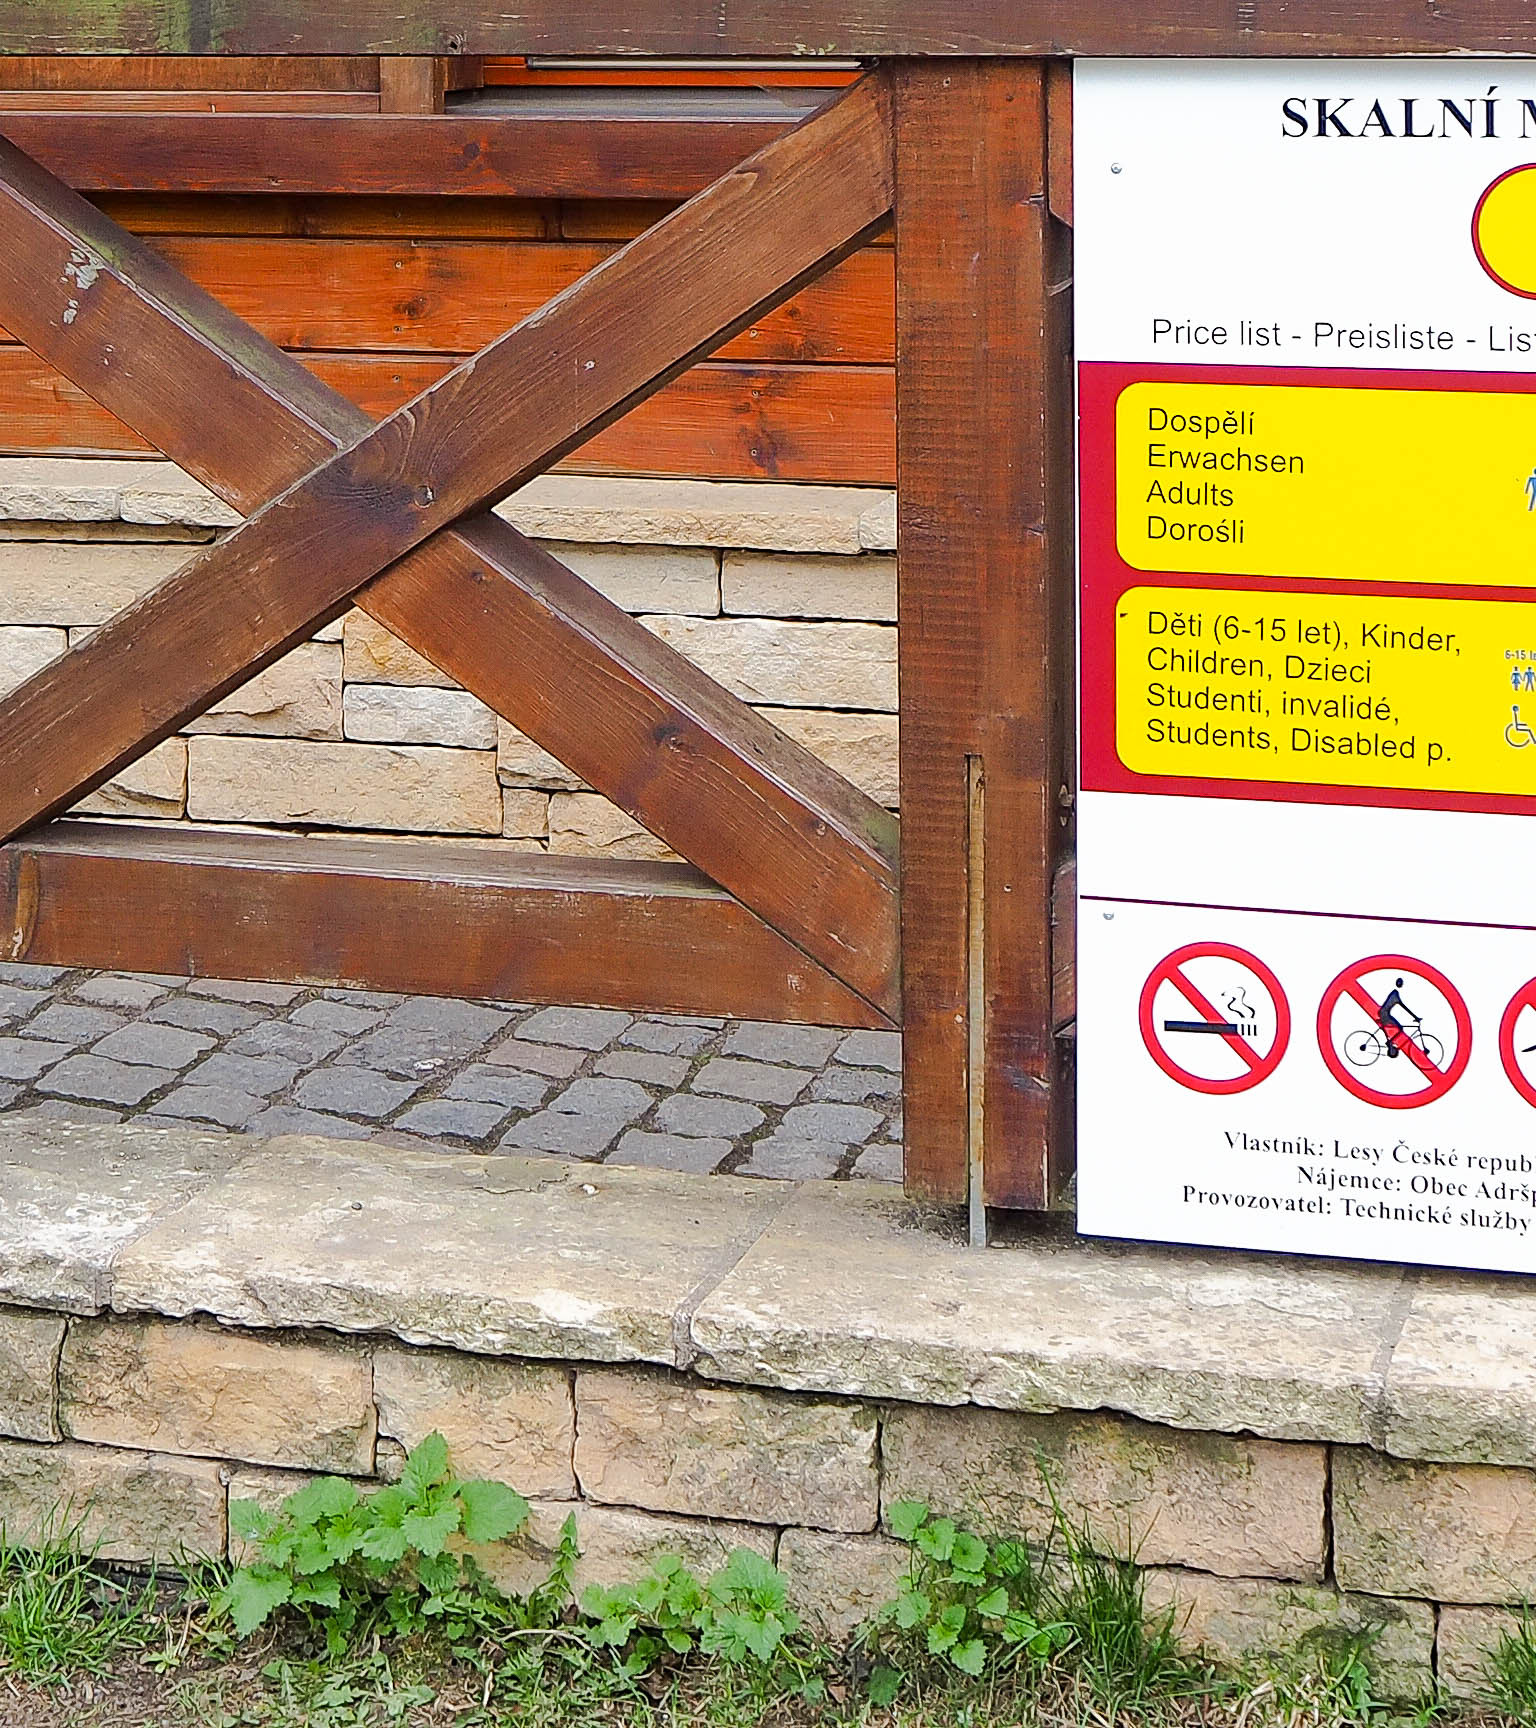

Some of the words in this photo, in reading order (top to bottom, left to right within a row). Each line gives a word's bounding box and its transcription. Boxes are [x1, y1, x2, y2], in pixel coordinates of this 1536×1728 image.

[1281, 85, 1500, 139] SKALNÍ
[1153, 318, 1228, 345] Price
[1240, 320, 1282, 347] list
[1314, 322, 1454, 351] Preisliste
[1148, 407, 1255, 440] Dospělí
[1148, 443, 1304, 474] Erwachsen
[1146, 479, 1234, 507] Adults
[1147, 515, 1244, 544] Dorośli
[1148, 611, 1202, 638] Děti
[1213, 614, 1286, 646] (6-15
[1298, 619, 1348, 652] let),
[1361, 622, 1460, 656] Kinder,
[1147, 646, 1272, 682] Children,
[1285, 654, 1371, 684] Dzieci
[1146, 682, 1270, 718] Studenti,
[1282, 690, 1399, 726] invalidé,
[1146, 718, 1278, 754] Students,
[1291, 727, 1415, 759] Disabled
[1427, 742, 1451, 767] p.
[1333, 1139, 1384, 1167] Lesy
[1392, 1139, 1459, 1167] České
[1410, 1175, 1468, 1197] Obec
[1339, 1197, 1452, 1225] Technické
[1459, 1208, 1532, 1237] služby
